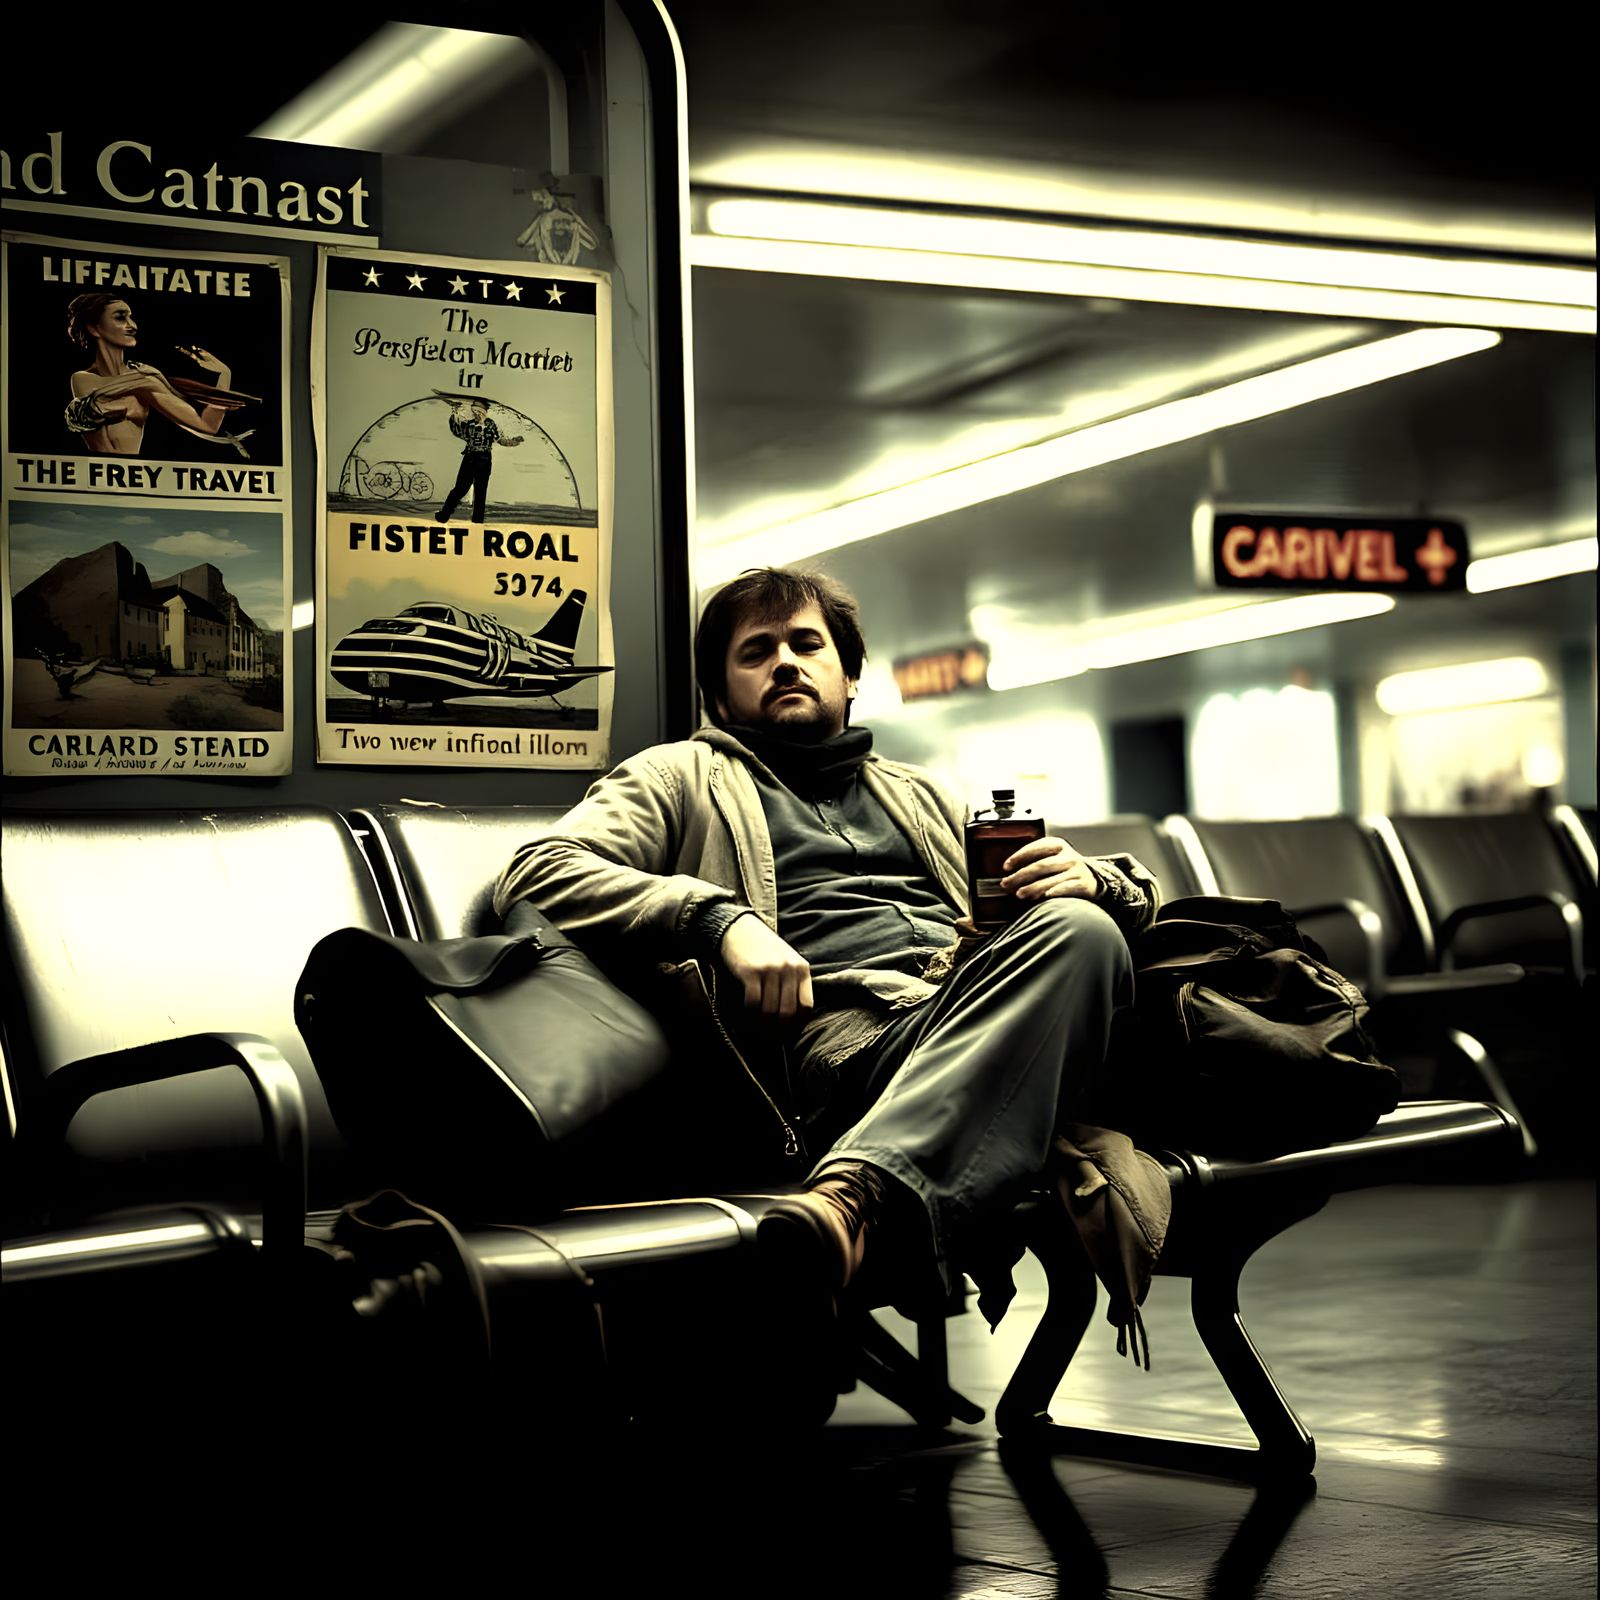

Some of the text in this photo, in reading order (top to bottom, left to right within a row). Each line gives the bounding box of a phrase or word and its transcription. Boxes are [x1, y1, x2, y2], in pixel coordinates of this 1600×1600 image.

[96, 140, 370, 229] Catnast
[42, 256, 251, 297] LIFFAITATEE
[441, 308, 488, 334] The
[17, 458, 76, 485] THE
[88, 463, 163, 489] FREY
[349, 523, 579, 563] FISTET ROAL
[28, 735, 158, 756] CARLARD
